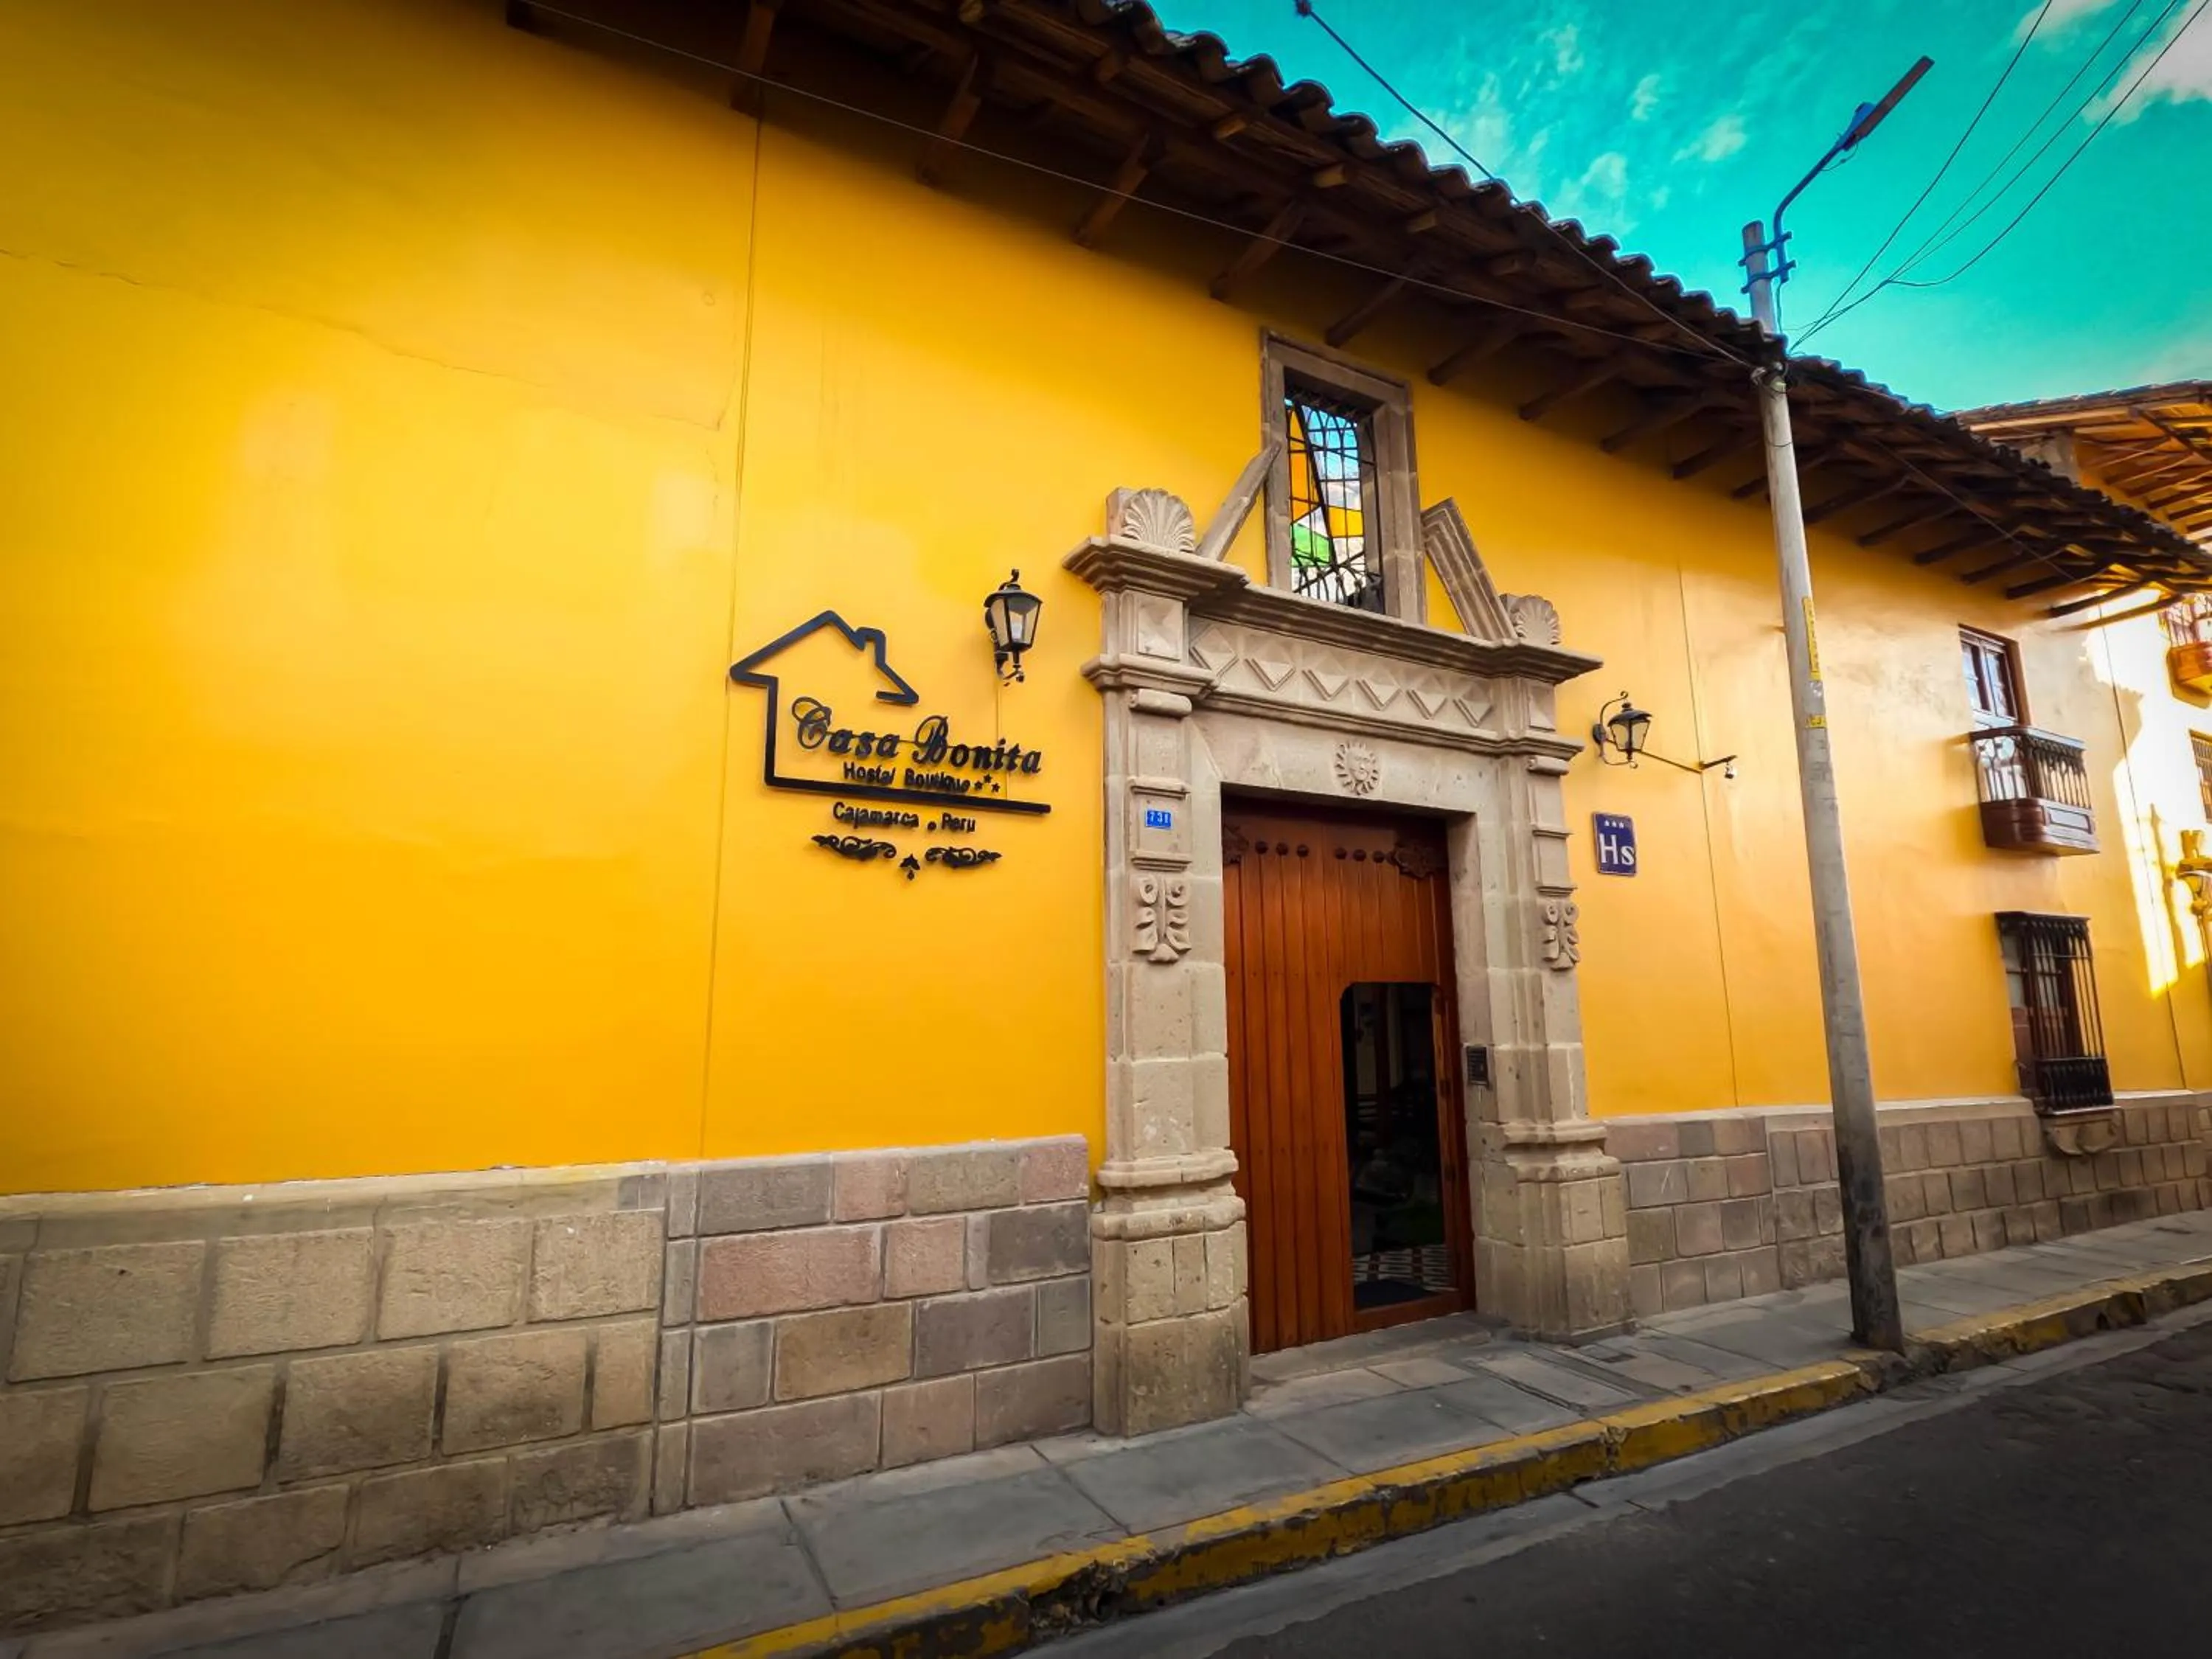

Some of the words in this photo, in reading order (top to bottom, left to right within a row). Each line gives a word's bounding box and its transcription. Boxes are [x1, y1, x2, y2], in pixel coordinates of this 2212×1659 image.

[792, 697, 900, 759] Casa
[912, 714, 1043, 773] Bonita
[905, 768, 971, 793] Boutique
[833, 801, 919, 830] Cajamarca
[1599, 832, 1635, 866] Hs
